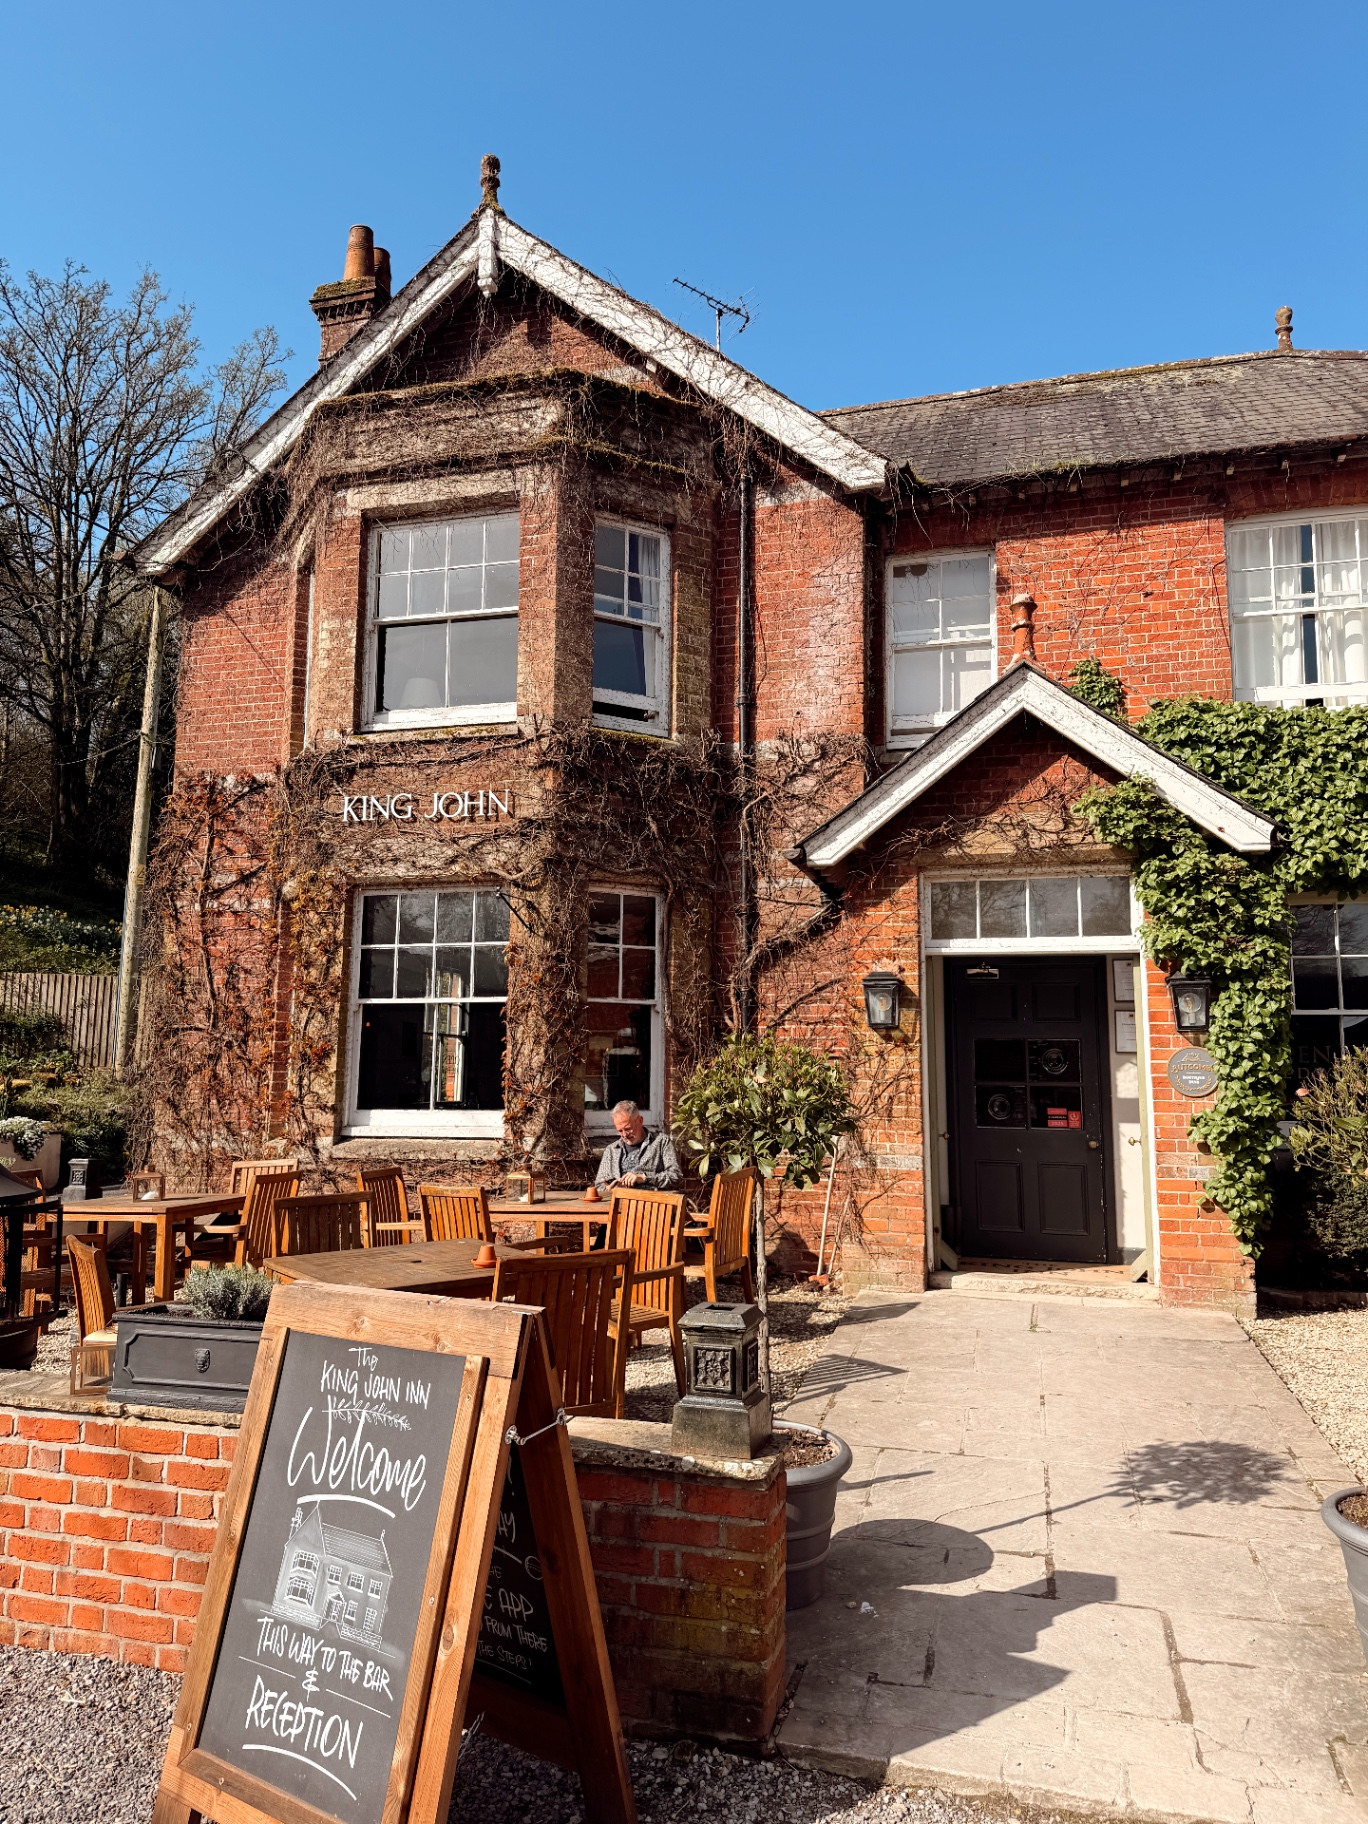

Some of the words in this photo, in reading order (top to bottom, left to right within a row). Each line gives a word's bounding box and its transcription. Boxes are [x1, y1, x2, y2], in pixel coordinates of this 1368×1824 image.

[342, 793, 413, 822] KING
[424, 789, 510, 819] JOHN
[348, 1347, 379, 1371] The
[320, 1360, 359, 1406] KING
[364, 1373, 401, 1403] JOHN
[405, 1379, 431, 1410] INN
[287, 1394, 427, 1511] Welcome
[498, 1587, 533, 1622] APP
[512, 1622, 548, 1653] THERE
[257, 1616, 288, 1657] THIS
[288, 1632, 324, 1666] WAY
[320, 1647, 337, 1673] TO
[339, 1651, 363, 1684] THE
[363, 1660, 394, 1702] BAR
[301, 1667, 320, 1702] &
[245, 1674, 363, 1769] RECEPTION
